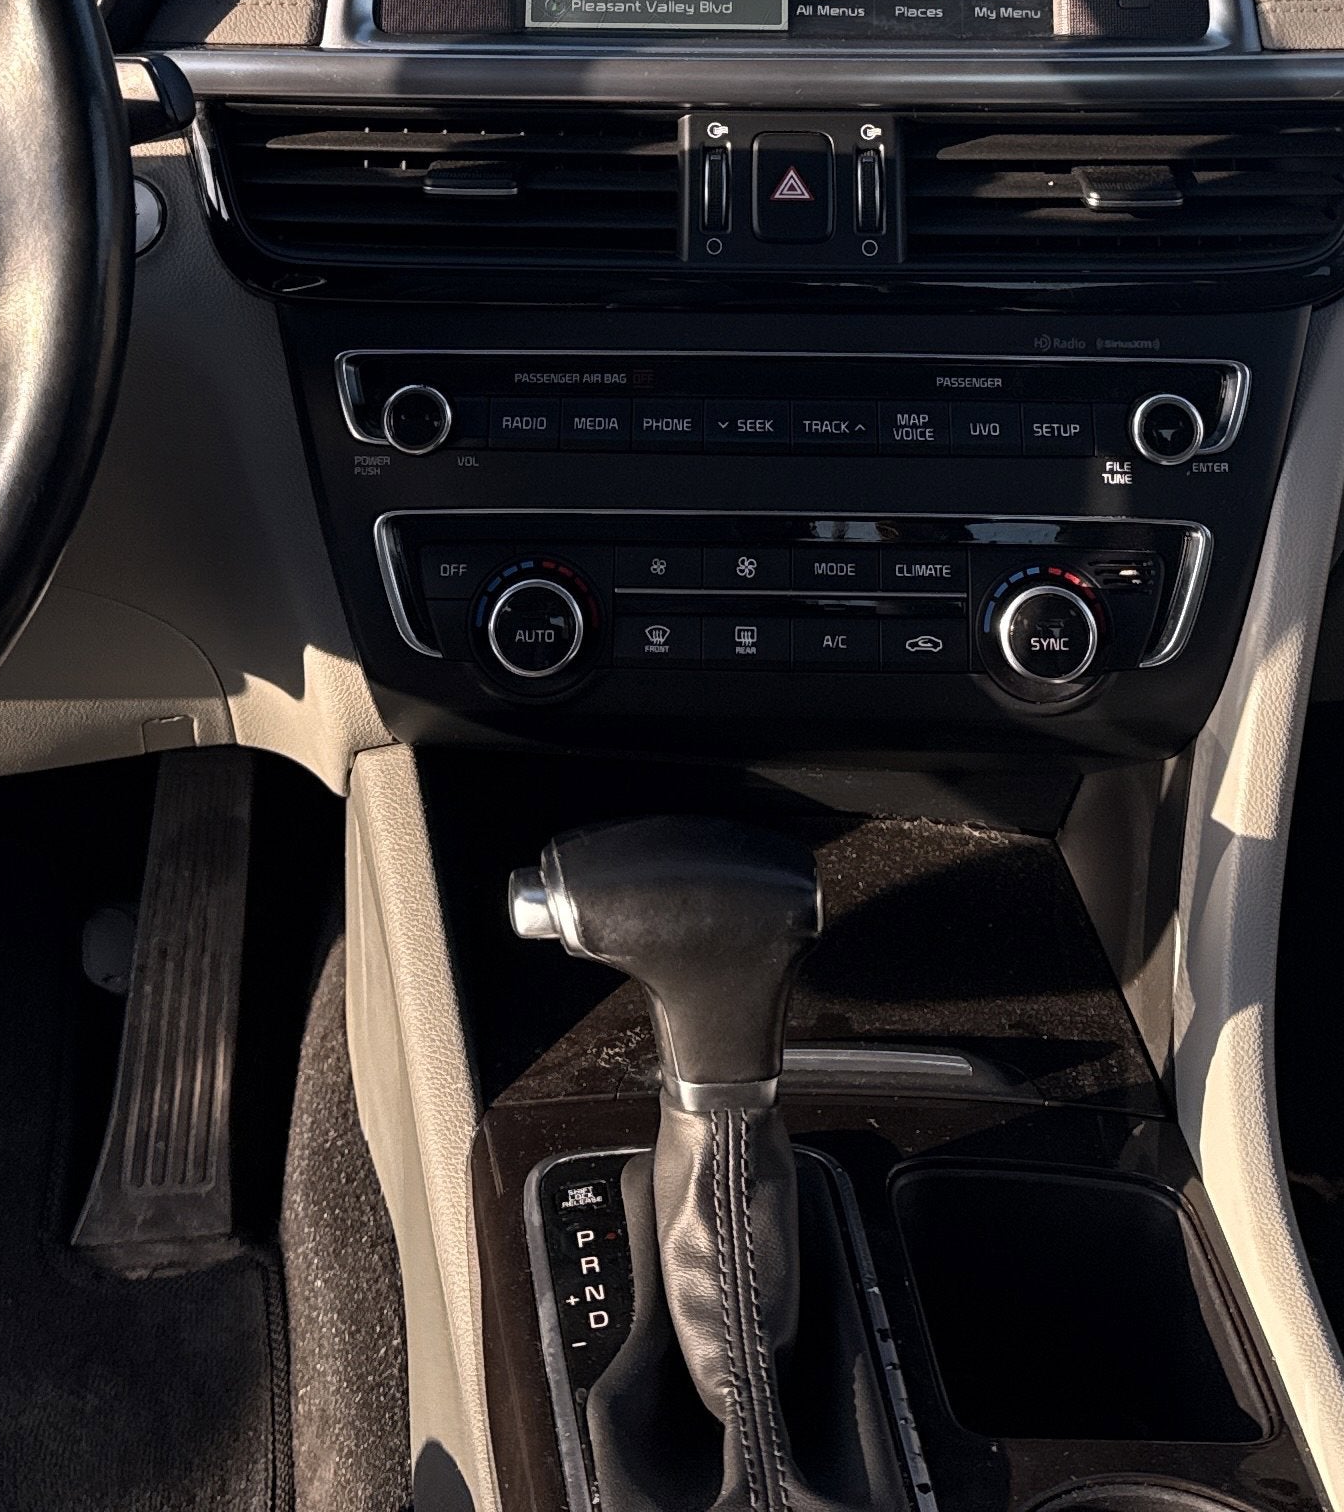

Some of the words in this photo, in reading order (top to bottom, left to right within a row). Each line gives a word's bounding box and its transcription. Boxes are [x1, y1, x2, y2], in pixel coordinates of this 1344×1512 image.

[571, 0, 642, 14] Pleasant
[645, 0, 695, 16] Valley
[699, 1, 733, 15] Blvd
[796, 5, 813, 17] All
[817, 5, 865, 18] Menus
[894, 6, 944, 18] Places
[974, 6, 996, 20] My
[999, 7, 1041, 19] Menu
[1053, 336, 1087, 350] Radio
[514, 372, 580, 384] PASSENGER
[582, 373, 602, 384] AIR
[603, 373, 627, 384] BAG
[936, 376, 1003, 389] PASSENGER
[502, 416, 547, 431] RADIO
[573, 417, 619, 431] MEDIA
[642, 418, 692, 432] PHONE
[737, 418, 774, 433] SEEK
[896, 412, 930, 427] MAP
[802, 420, 850, 434] TRACK
[969, 422, 1000, 437] UVO
[1033, 423, 1081, 438] SETUP
[892, 427, 935, 442] VOICE
[354, 455, 391, 466] POWER
[457, 455, 480, 467] VOL
[1105, 461, 1132, 473] FILE
[1192, 462, 1229, 473] ENTER
[354, 466, 381, 476] PUSH
[1101, 473, 1133, 485] TUNE
[439, 563, 468, 577] OFF
[814, 562, 856, 576] MODE
[894, 563, 952, 579] CLIMATE
[515, 629, 555, 644] AUTO
[822, 634, 848, 650] A/C
[644, 645, 670, 654] FRONT
[735, 646, 757, 655] REAR
[1030, 636, 1070, 652] SYNC
[576, 1230, 595, 1248] P
[580, 1256, 601, 1275] R
[585, 1284, 606, 1302] N
[588, 1310, 609, 1329] D
